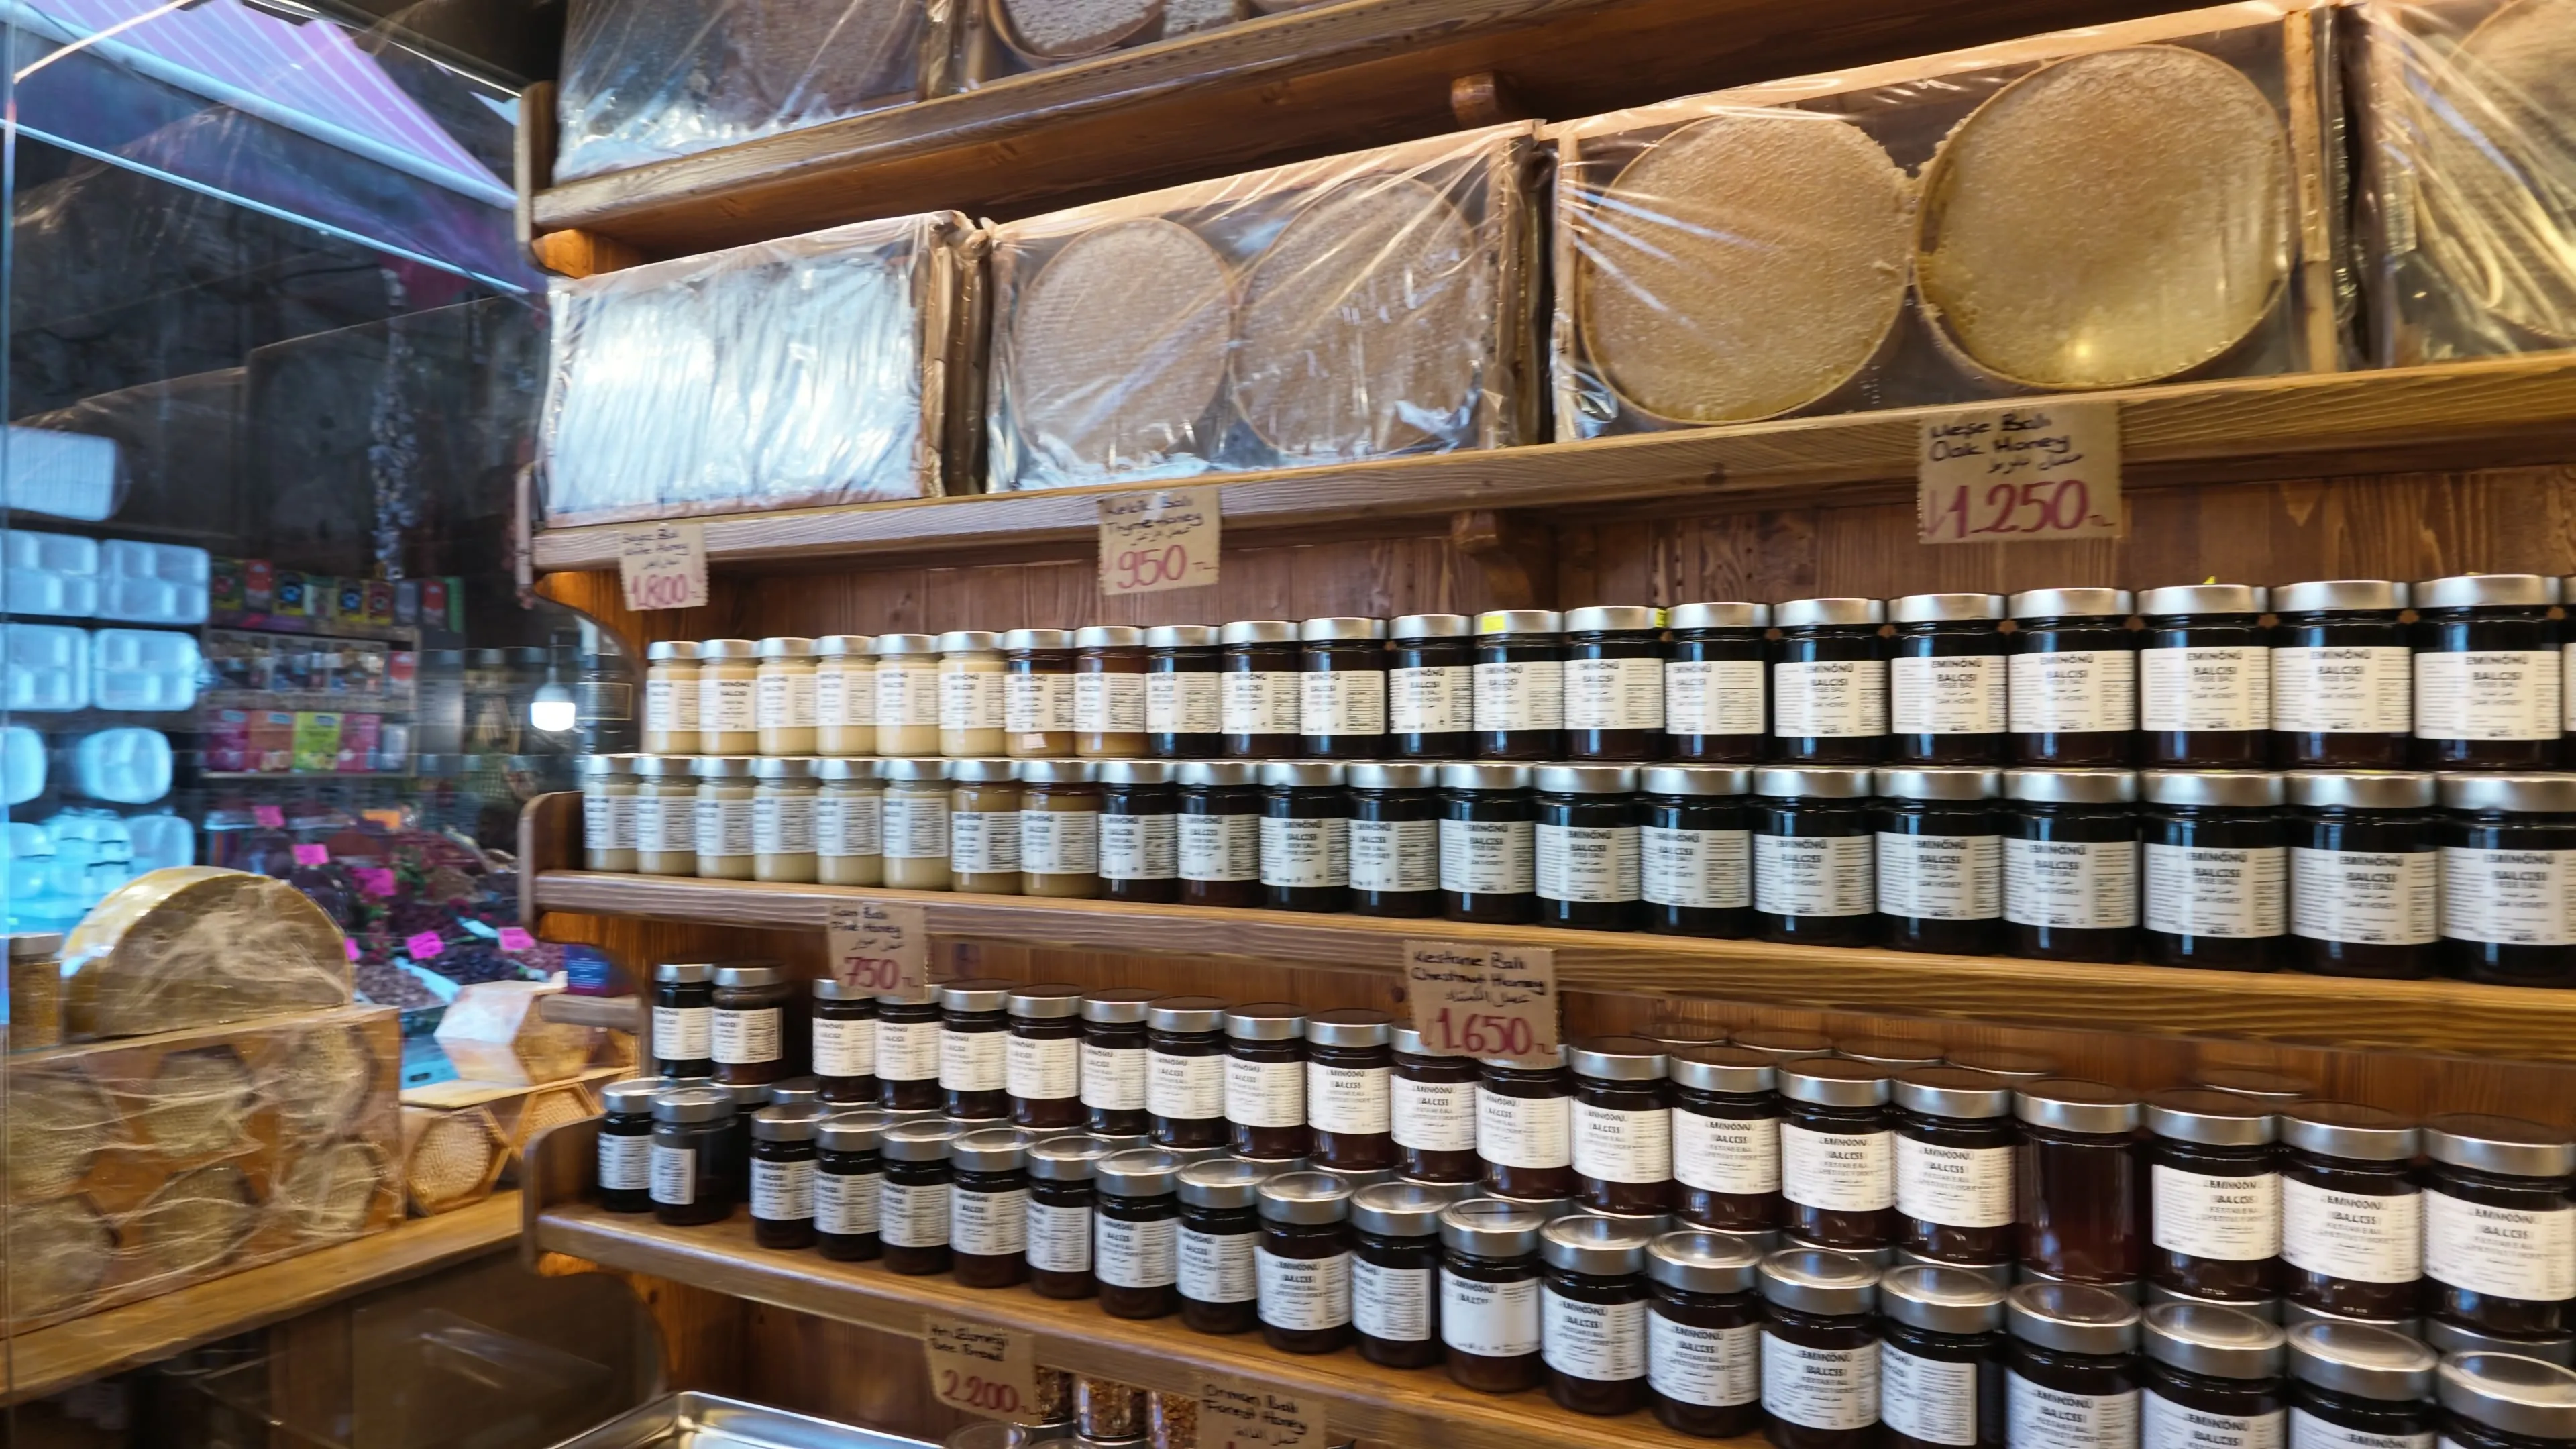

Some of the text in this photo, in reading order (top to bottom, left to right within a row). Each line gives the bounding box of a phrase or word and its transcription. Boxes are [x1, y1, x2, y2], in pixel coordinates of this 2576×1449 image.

[1928, 435, 2071, 462] Oak Honey
[1116, 543, 1189, 590] 950
[843, 955, 900, 991] 750
[1490, 973, 1547, 996] Honey
